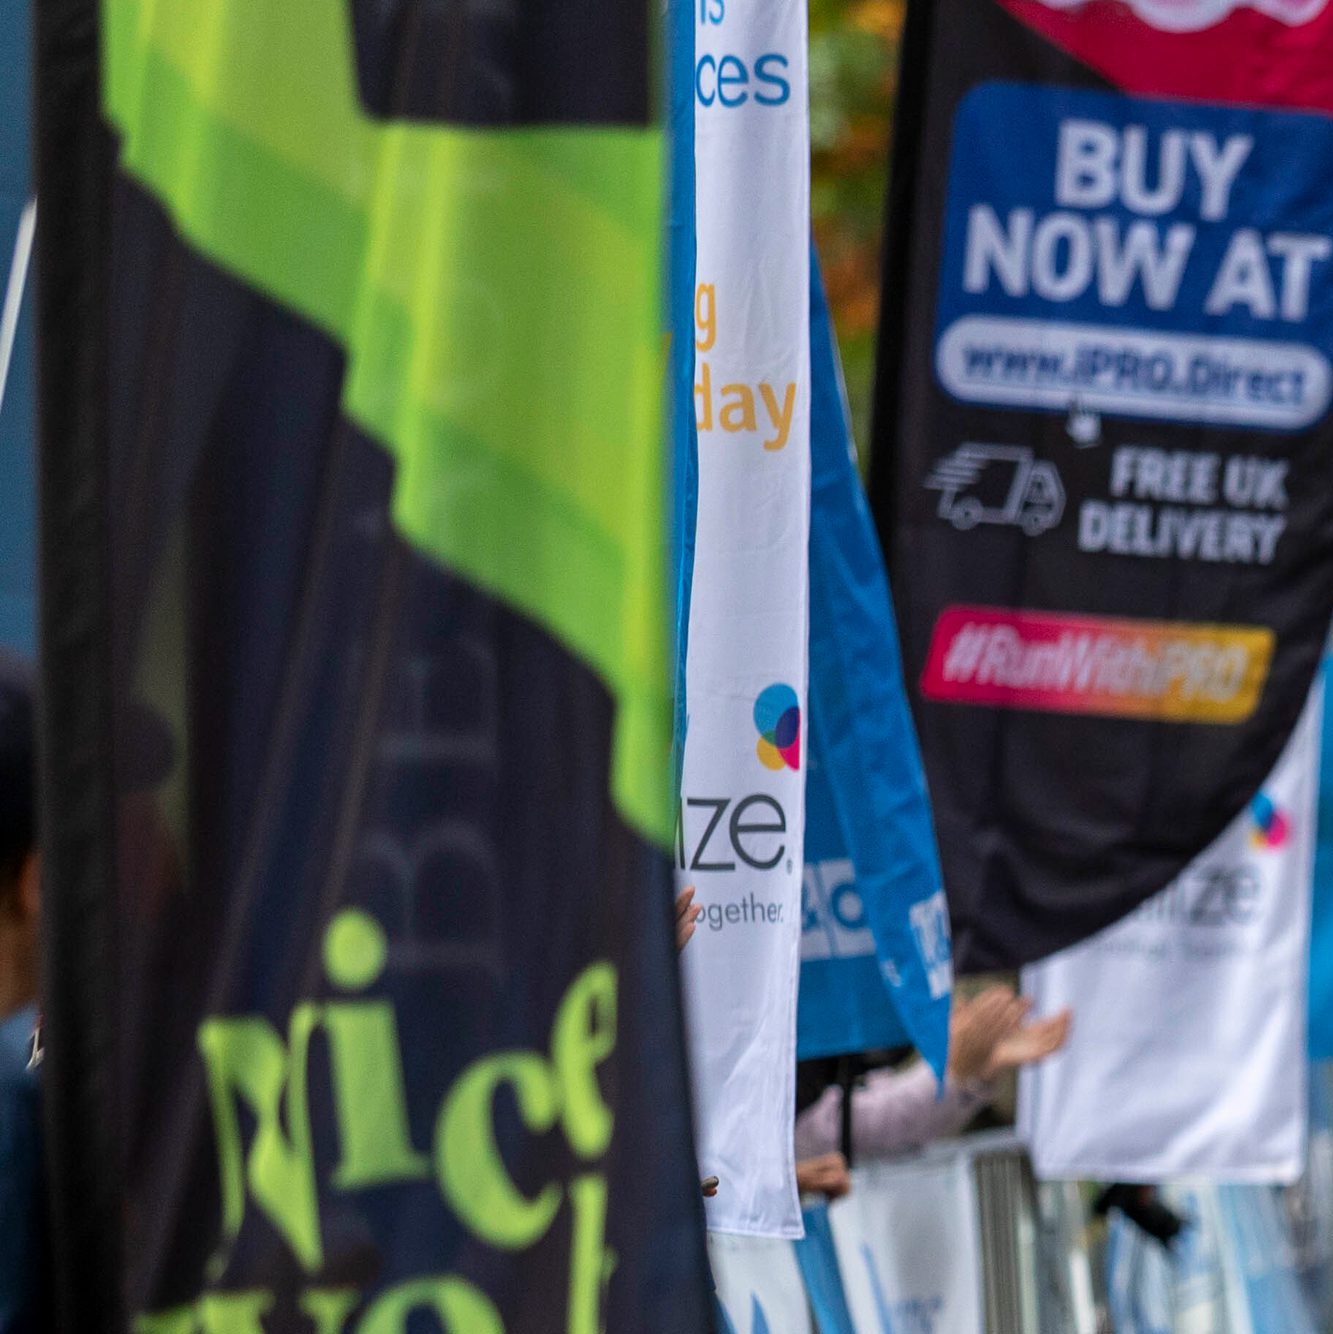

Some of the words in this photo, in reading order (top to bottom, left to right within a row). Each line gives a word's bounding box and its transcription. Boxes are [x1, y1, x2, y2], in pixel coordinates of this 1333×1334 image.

[1055, 119, 1254, 221] BUY
[962, 204, 1196, 311] NOW
[1204, 228, 1333, 323] AT
[1110, 443, 1220, 505] FREE
[1225, 453, 1291, 509] UK
[1077, 499, 1287, 566] DELIVERY
